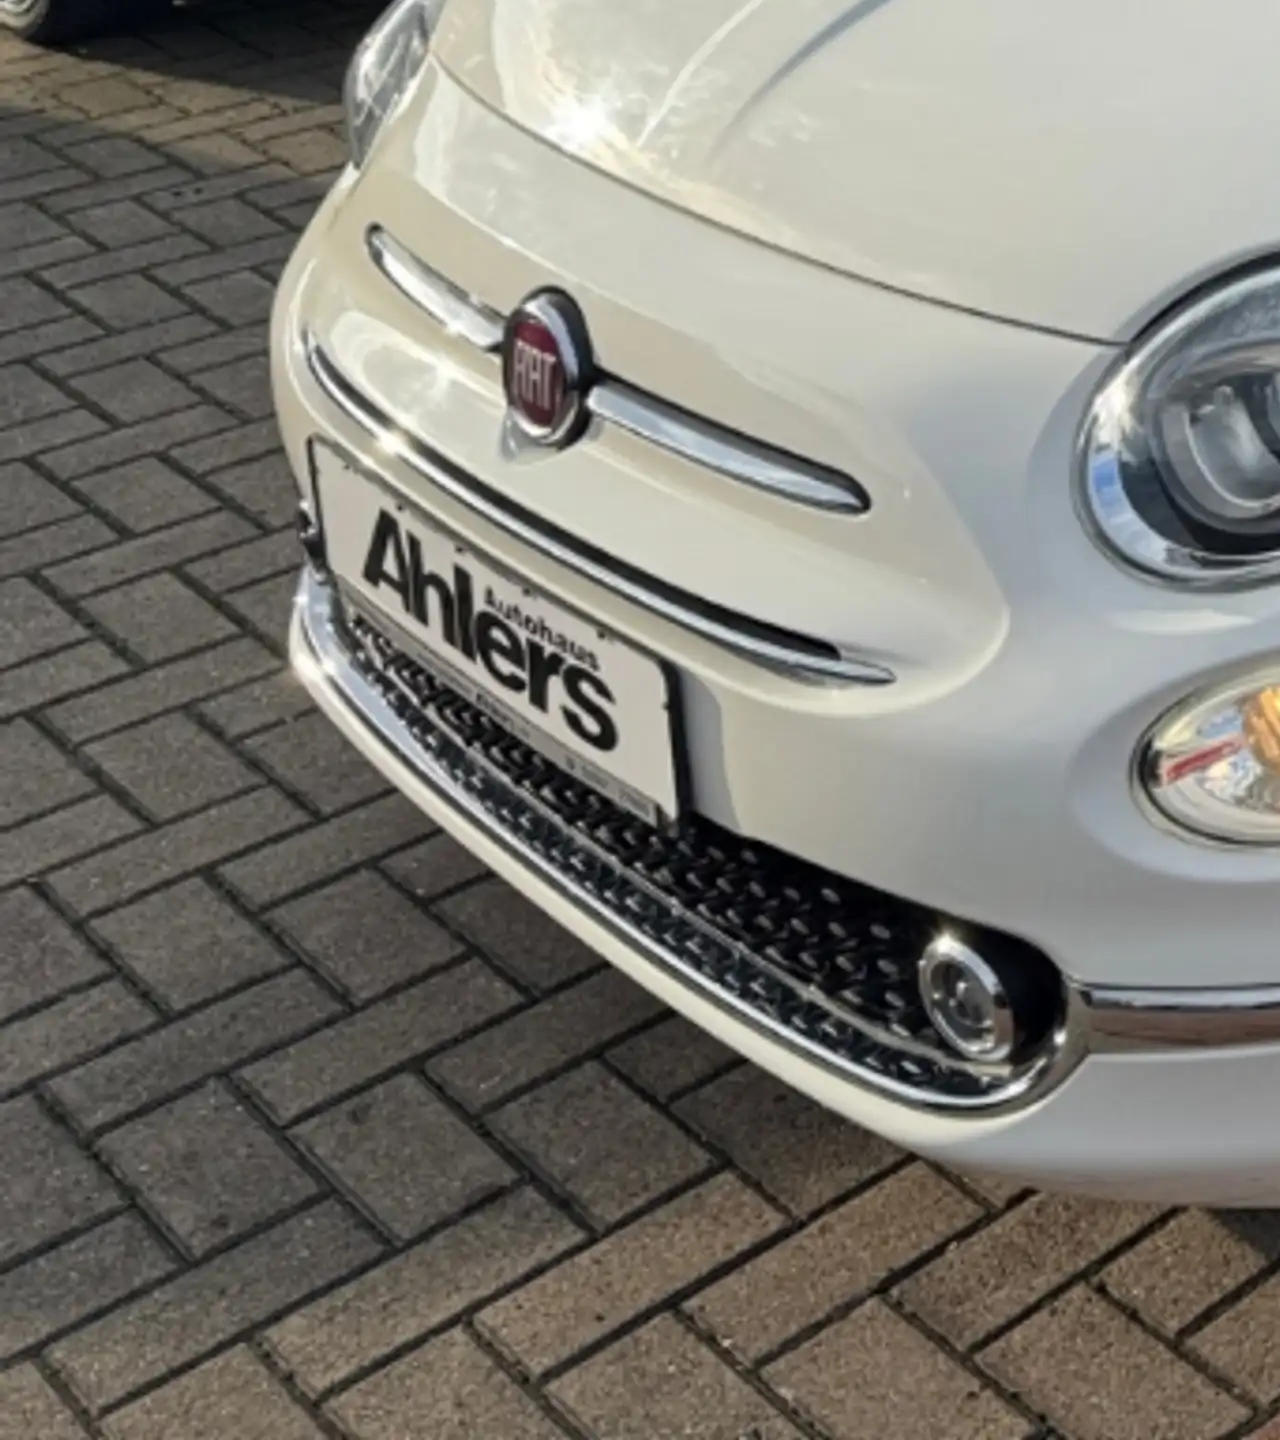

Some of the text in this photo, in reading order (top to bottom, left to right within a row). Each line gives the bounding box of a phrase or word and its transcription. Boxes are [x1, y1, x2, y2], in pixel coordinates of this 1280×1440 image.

[512, 337, 557, 410] FIAT
[363, 507, 619, 752] Ahlers
[484, 586, 601, 672] Autohaus
